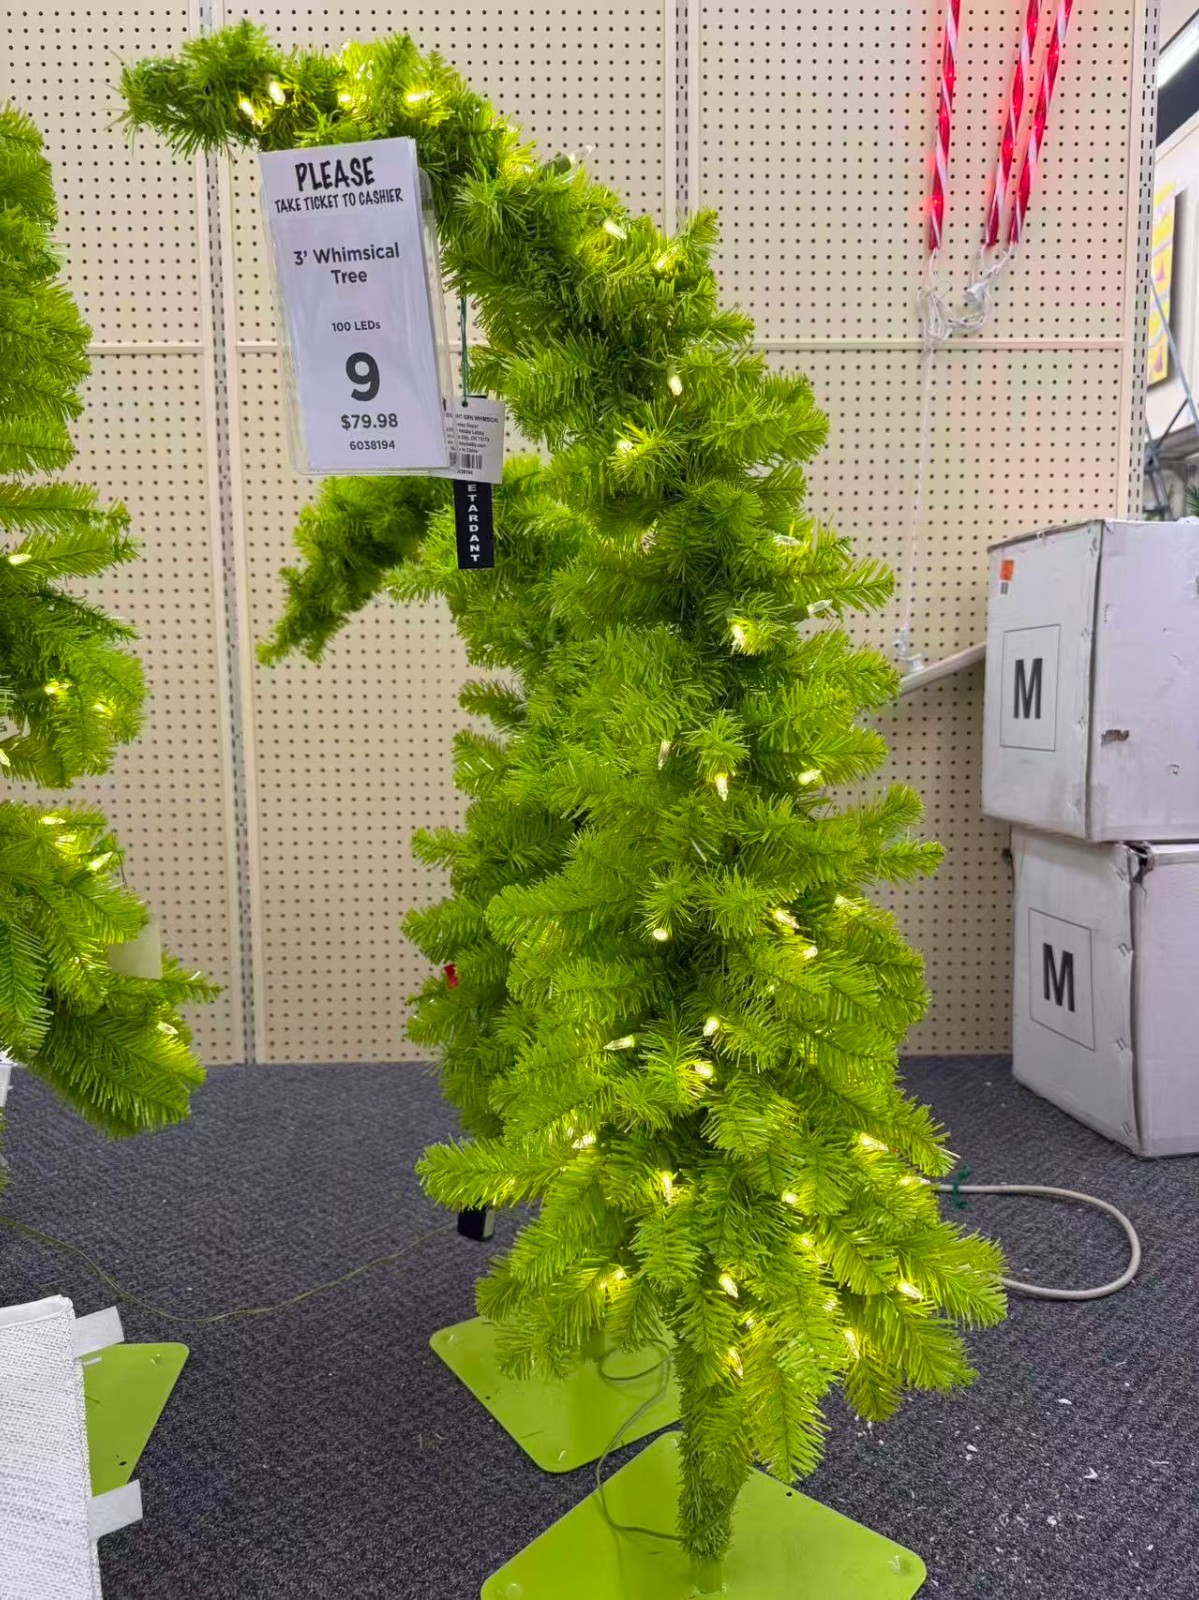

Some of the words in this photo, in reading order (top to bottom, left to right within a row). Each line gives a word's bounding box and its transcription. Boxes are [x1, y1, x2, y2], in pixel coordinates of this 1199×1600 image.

[295, 156, 375, 191] PLEASE
[274, 197, 302, 213] TAKE
[303, 193, 339, 211] TICKET
[342, 192, 357, 207] TO
[359, 187, 403, 206] CASHIER
[293, 250, 308, 266] 3'
[313, 242, 400, 264] Whimsical
[330, 269, 368, 284] Tree
[331, 321, 352, 332] 100
[354, 320, 381, 331] LEDs
[346, 352, 380, 402] 9
[340, 413, 399, 431] $79.98
[349, 440, 396, 451] 6038194
[467, 484, 480, 562] ETARDANT
[1013, 658, 1043, 719] M
[1043, 942, 1075, 1013] M
